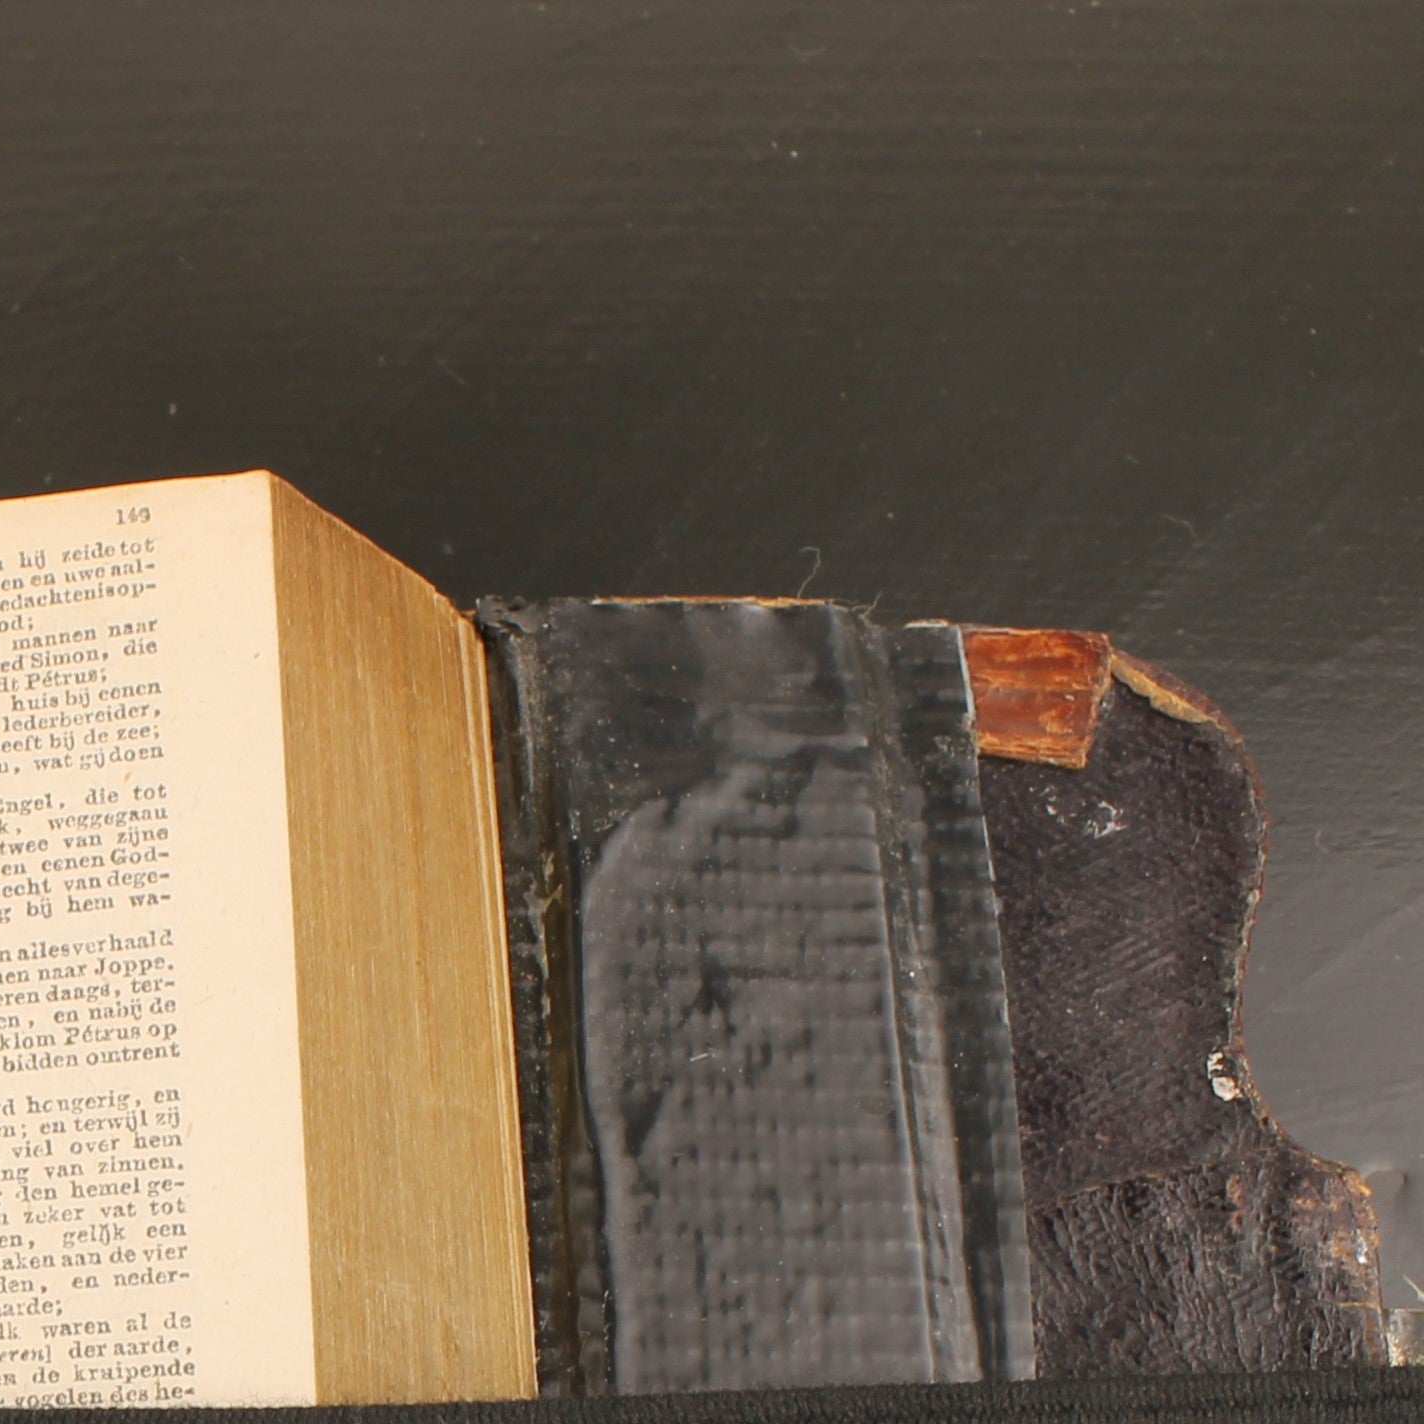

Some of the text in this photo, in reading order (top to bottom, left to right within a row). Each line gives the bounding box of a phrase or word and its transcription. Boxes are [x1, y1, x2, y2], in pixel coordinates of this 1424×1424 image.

[12, 628, 97, 651] mannen
[108, 619, 157, 638] naar
[85, 788, 118, 805] die
[133, 784, 167, 801] tot
[41, 1320, 112, 1339] waren
[126, 1312, 148, 1332] al
[163, 1311, 191, 1329] de
